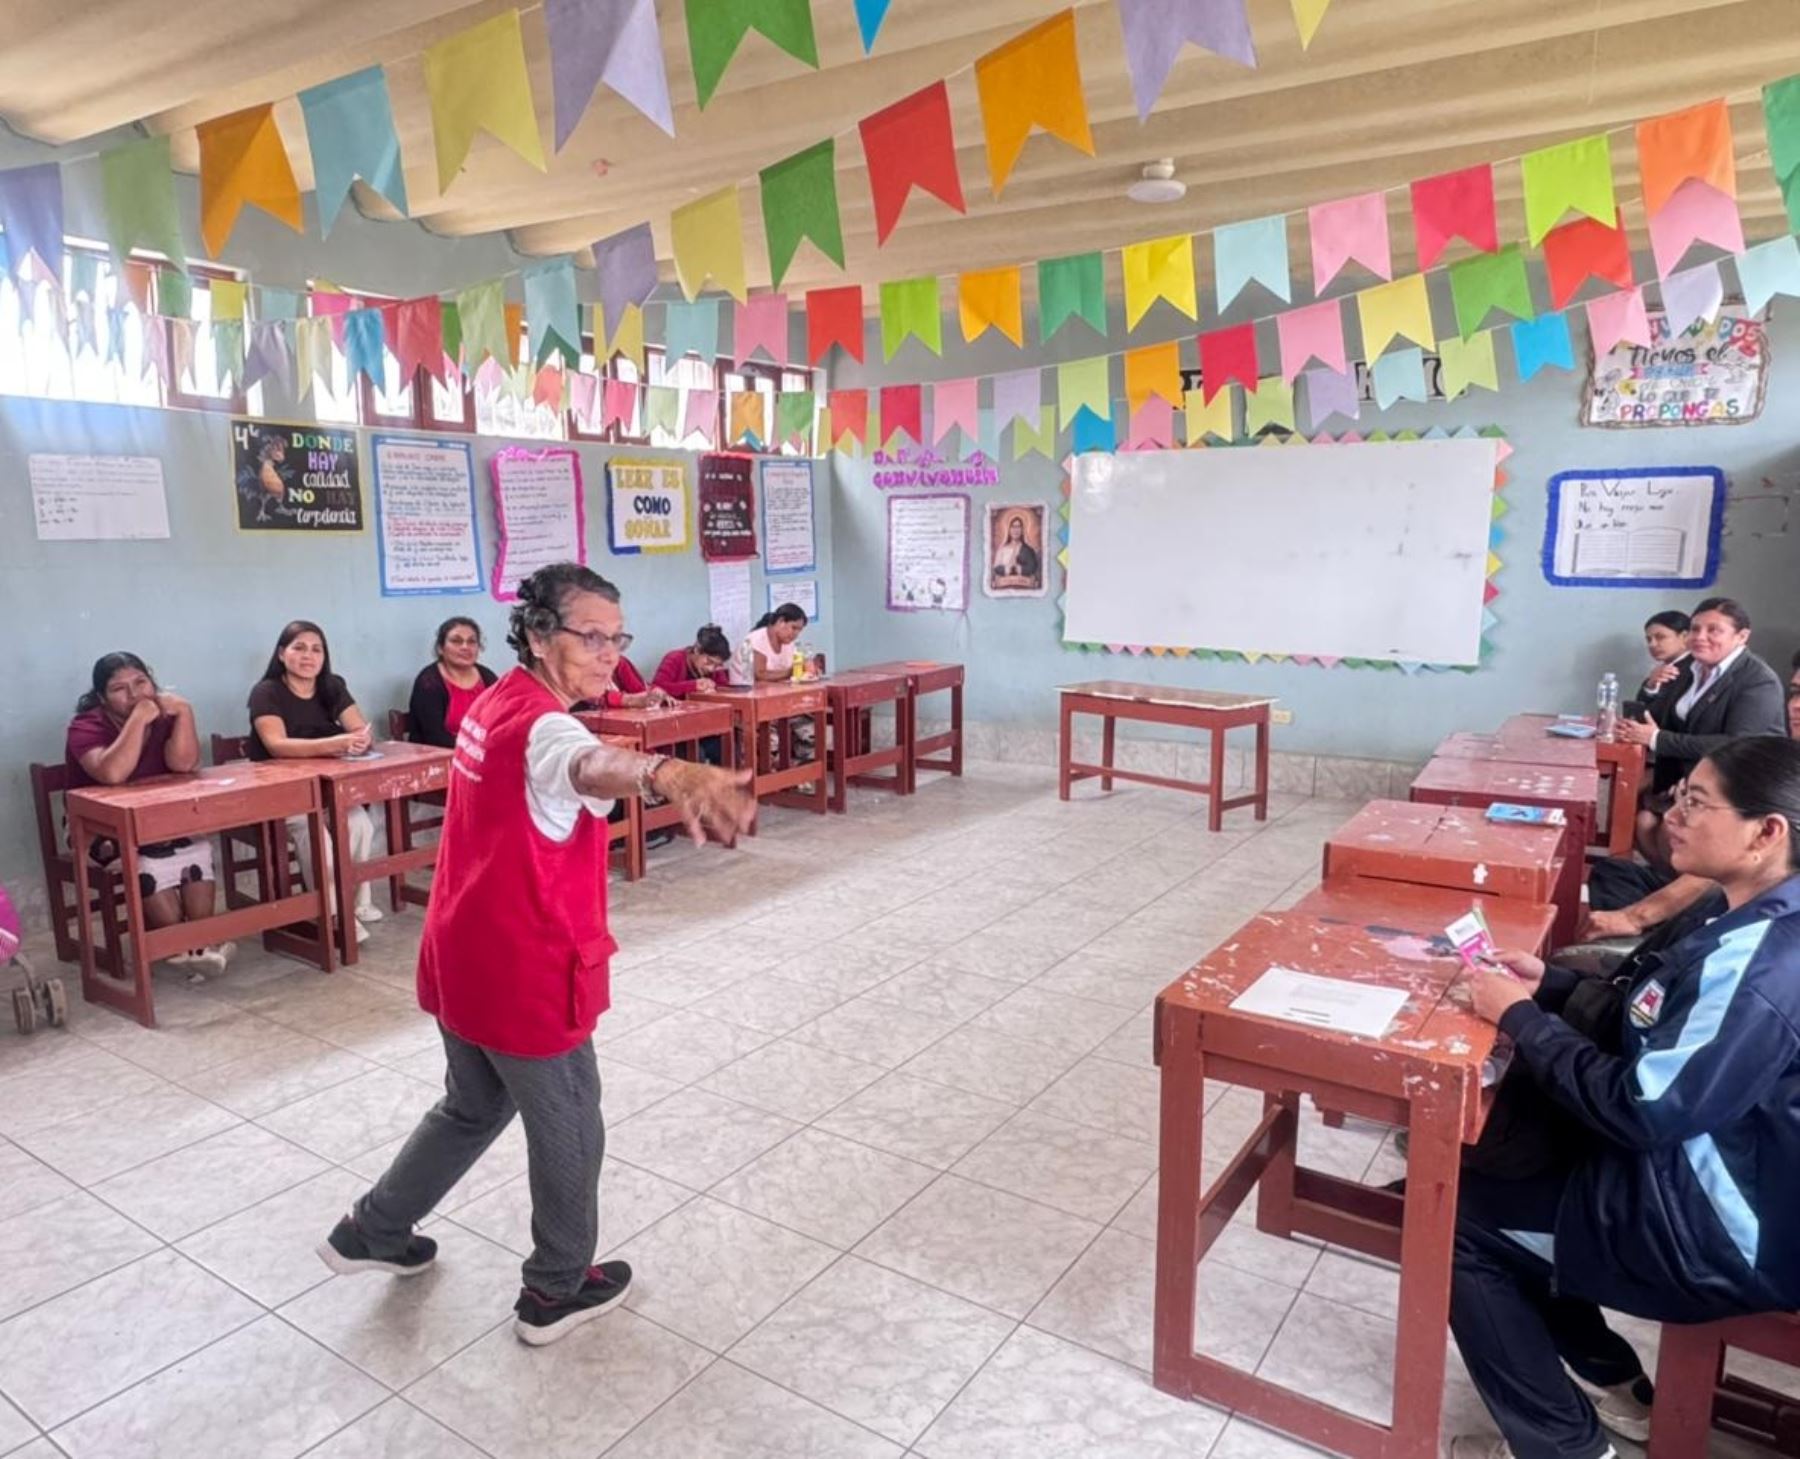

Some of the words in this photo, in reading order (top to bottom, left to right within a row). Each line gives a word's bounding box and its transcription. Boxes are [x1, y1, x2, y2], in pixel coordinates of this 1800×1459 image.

[1620, 399, 1740, 419] PROPONGAS
[291, 432, 354, 453] DONDE
[307, 451, 338, 471] HAY
[288, 488, 315, 504] NO
[633, 495, 671, 515] COMO
